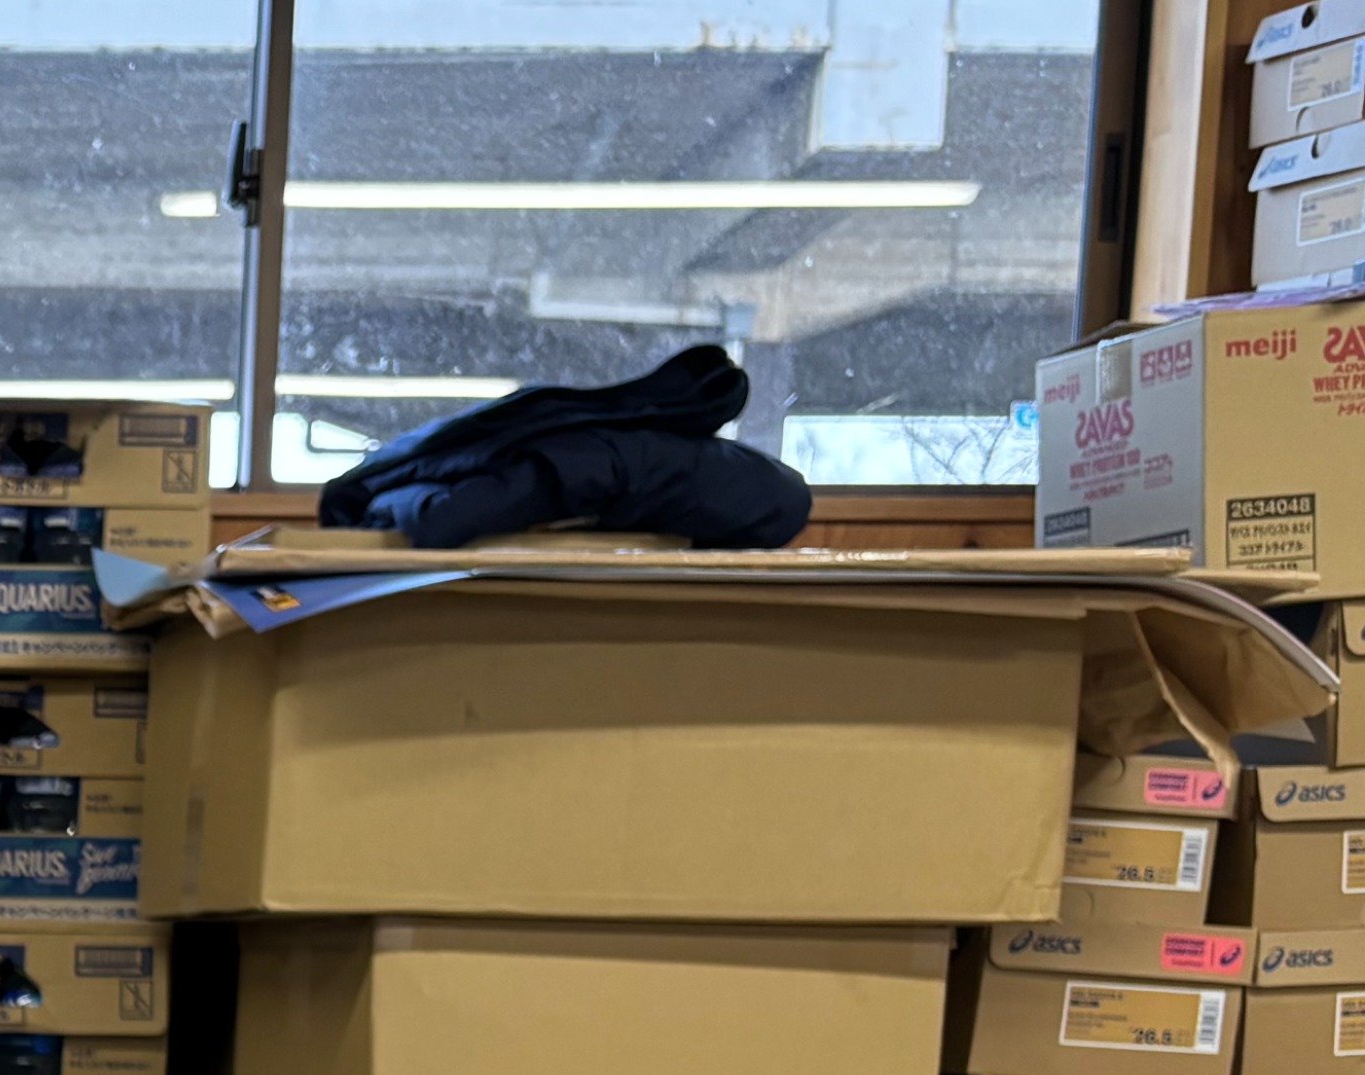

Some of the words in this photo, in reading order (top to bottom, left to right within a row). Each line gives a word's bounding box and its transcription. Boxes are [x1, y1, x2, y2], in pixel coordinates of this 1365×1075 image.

[1226, 329, 1297, 361] meiji
[1043, 373, 1081, 404] meiji
[1075, 397, 1135, 449] SAVAS
[1230, 496, 1312, 520] 2634048
[1299, 783, 1346, 802] asics
[1032, 935, 1081, 955] asics
[1285, 949, 1333, 969] asics
